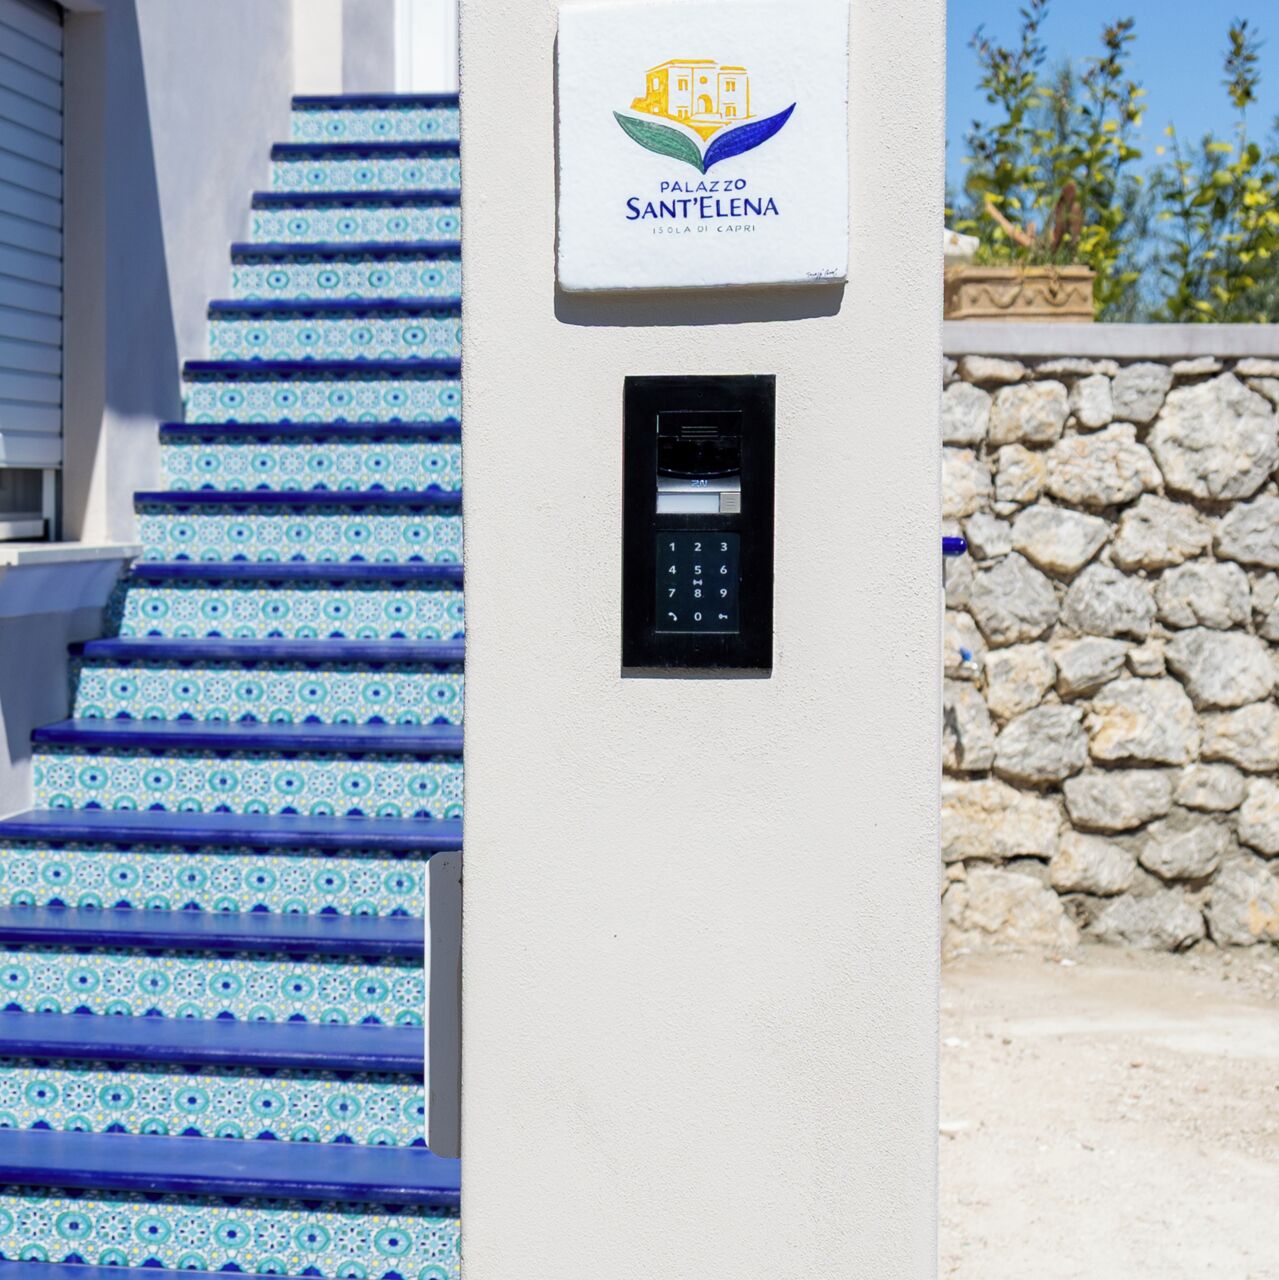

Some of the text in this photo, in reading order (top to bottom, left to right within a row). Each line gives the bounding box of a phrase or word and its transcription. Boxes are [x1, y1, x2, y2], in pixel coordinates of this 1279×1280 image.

[660, 178, 747, 193] PALAZZO
[625, 196, 779, 220] SANT'ELENA
[652, 224, 756, 234] ISOLA DI CAPRI
[669, 542, 728, 552] 1 2 3
[668, 565, 728, 575] 4 5 6
[668, 588, 728, 598] 7 8 9
[694, 612, 702, 622] 0
